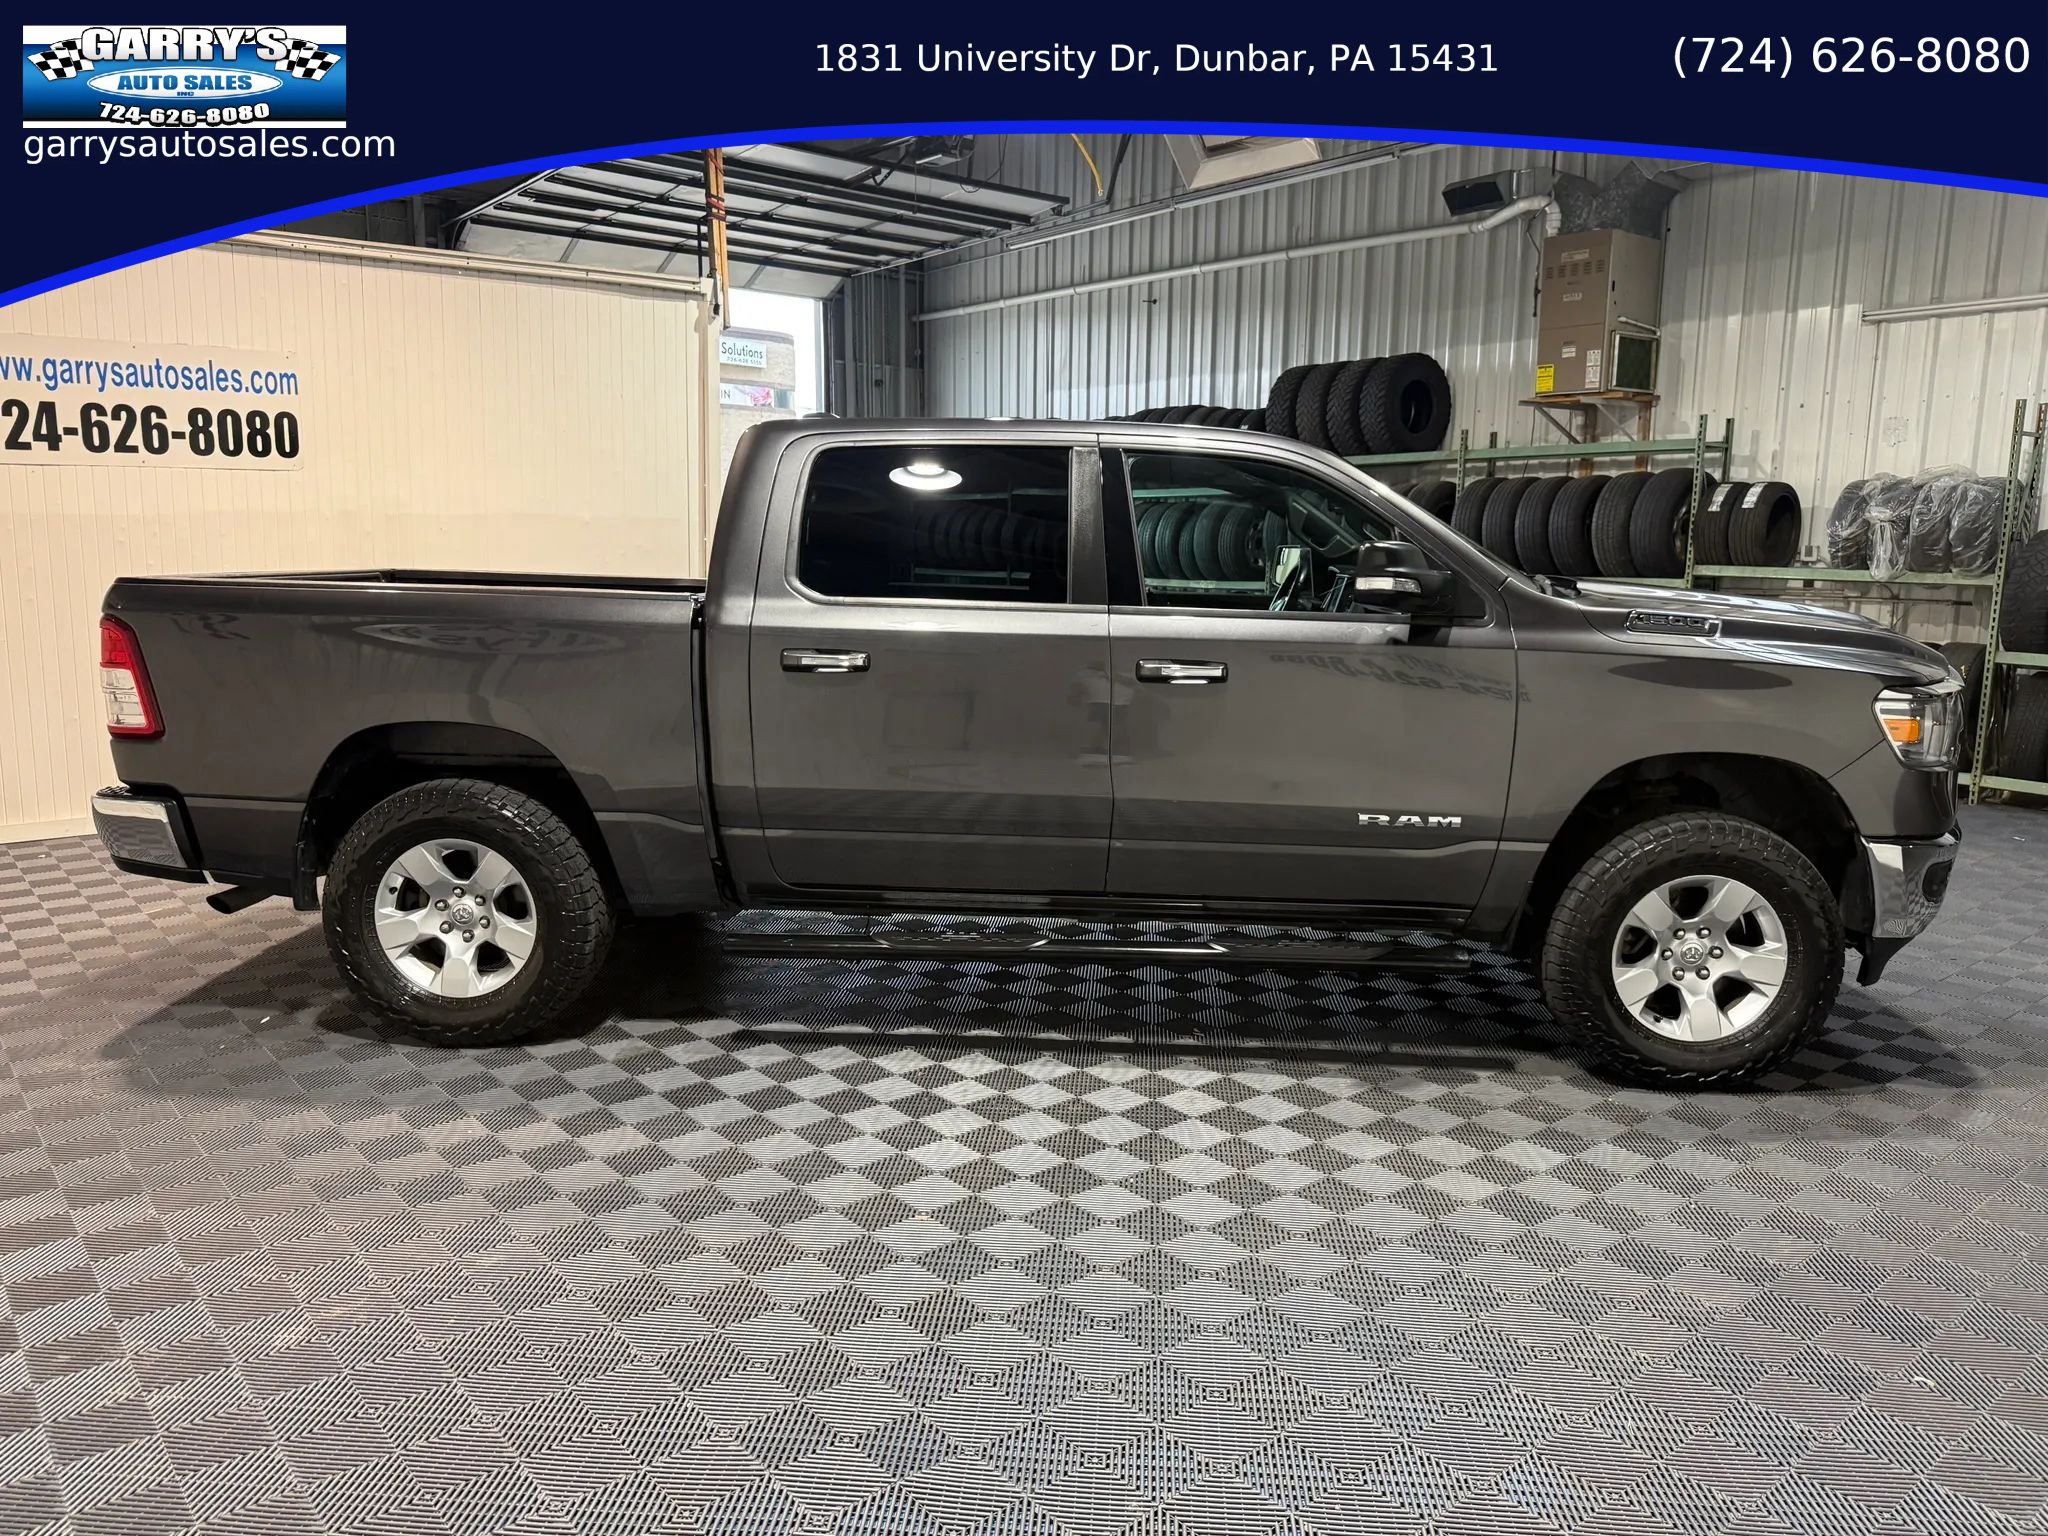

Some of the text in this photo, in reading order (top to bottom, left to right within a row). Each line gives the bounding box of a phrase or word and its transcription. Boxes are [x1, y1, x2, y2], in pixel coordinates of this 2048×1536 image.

[721, 341, 763, 360] Solutions
[0, 398, 300, 459] 24-626-8080
[1358, 812, 1462, 828] RAM
